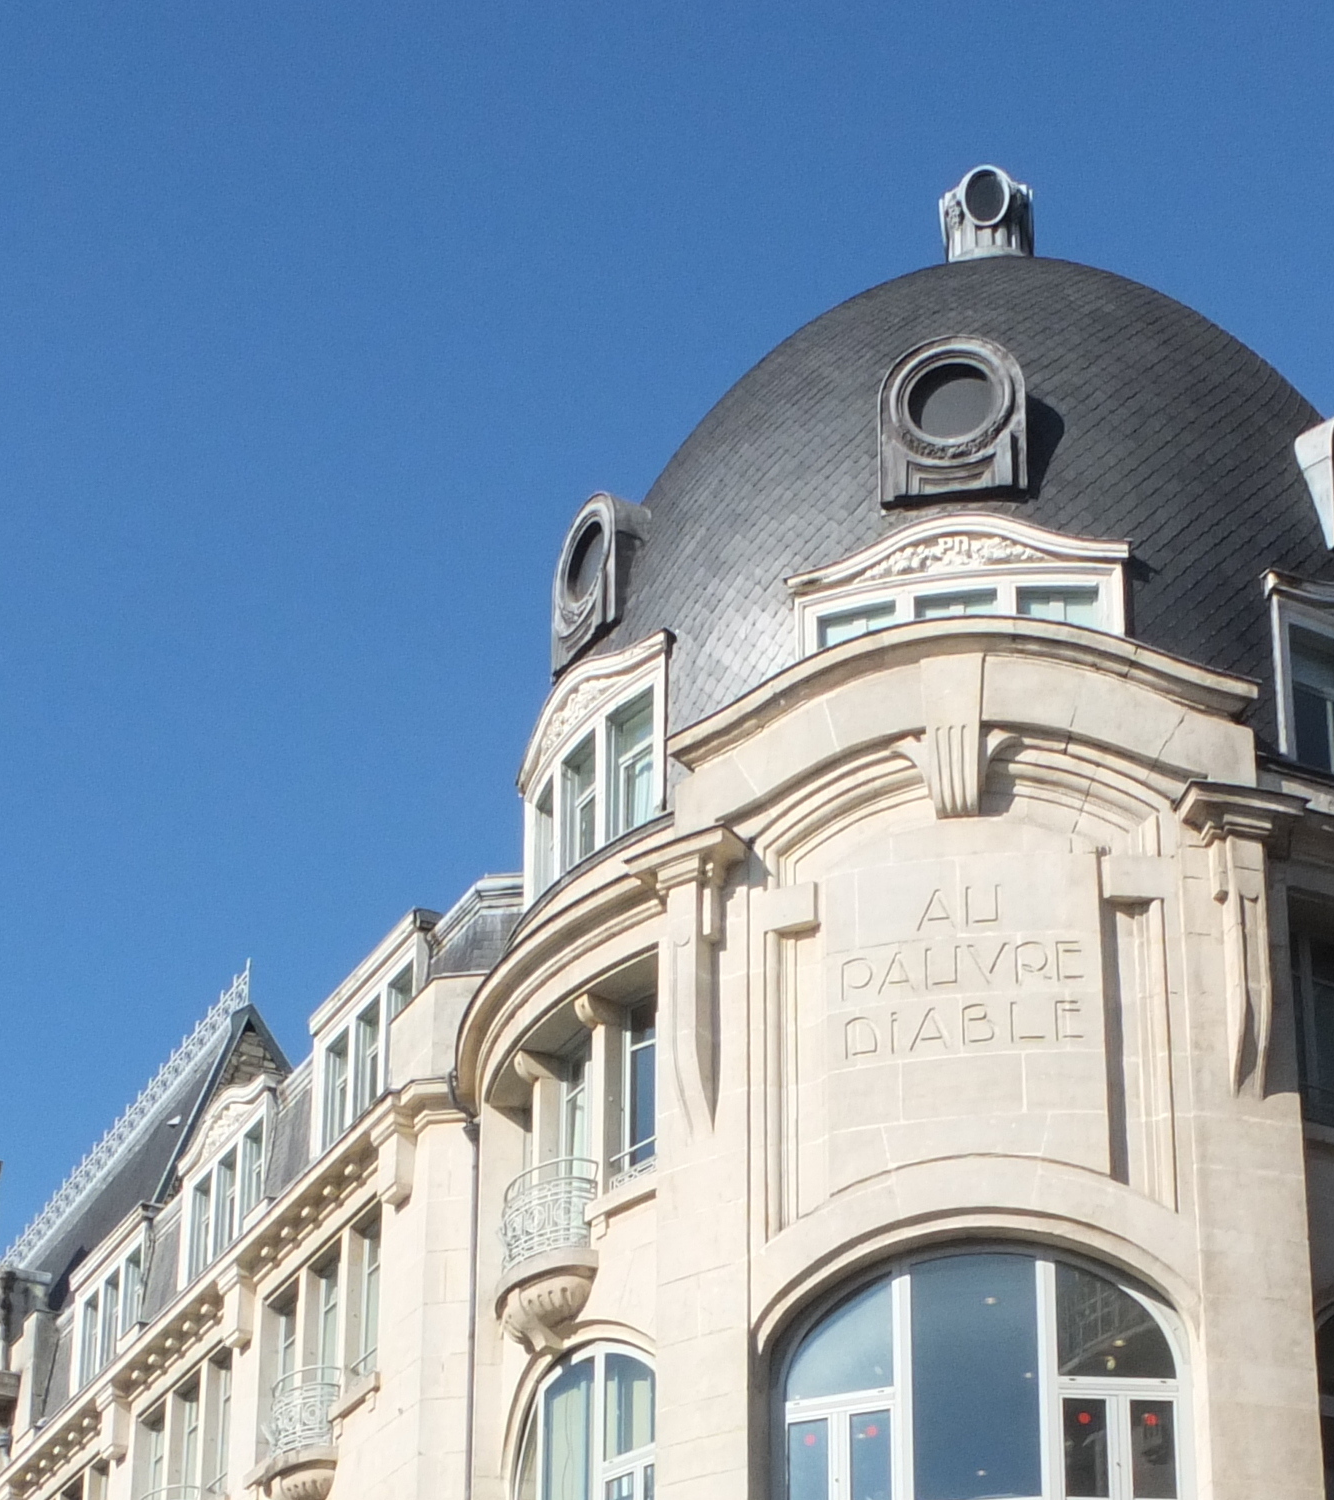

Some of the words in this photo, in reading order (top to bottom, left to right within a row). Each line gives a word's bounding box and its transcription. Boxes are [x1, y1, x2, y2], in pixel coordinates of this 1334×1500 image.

[916, 883, 1001, 933] AU
[840, 939, 1086, 1002] PAUVRE
[843, 999, 1086, 1061] DIABLE
